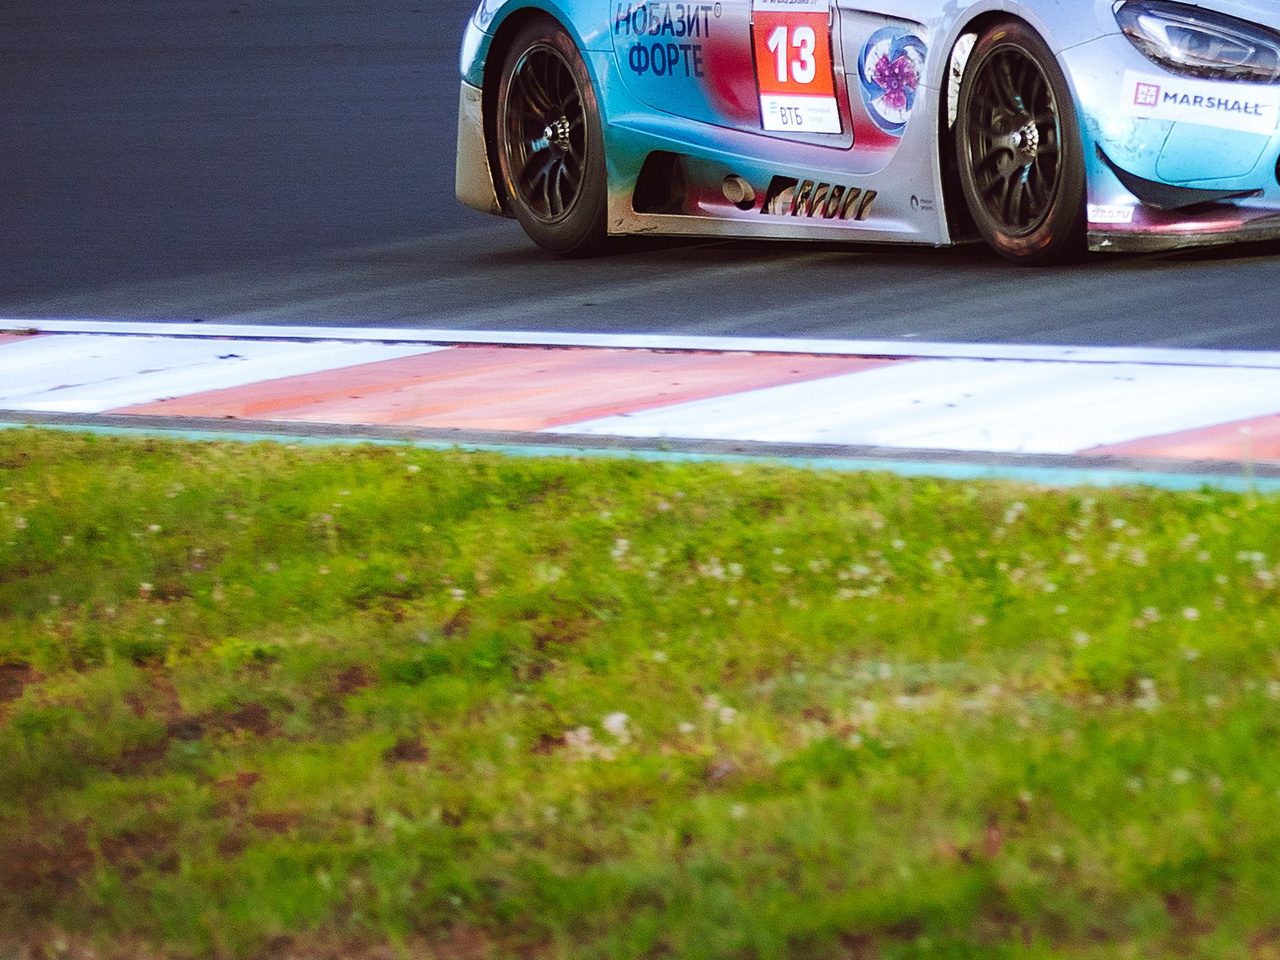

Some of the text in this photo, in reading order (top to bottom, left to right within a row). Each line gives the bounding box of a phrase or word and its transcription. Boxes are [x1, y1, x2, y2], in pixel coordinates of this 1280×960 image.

[629, 42, 705, 78] ФОРТЕ
[767, 26, 816, 84] 13
[780, 106, 803, 126] ВТБ
[1163, 91, 1263, 116] MARSHALL
